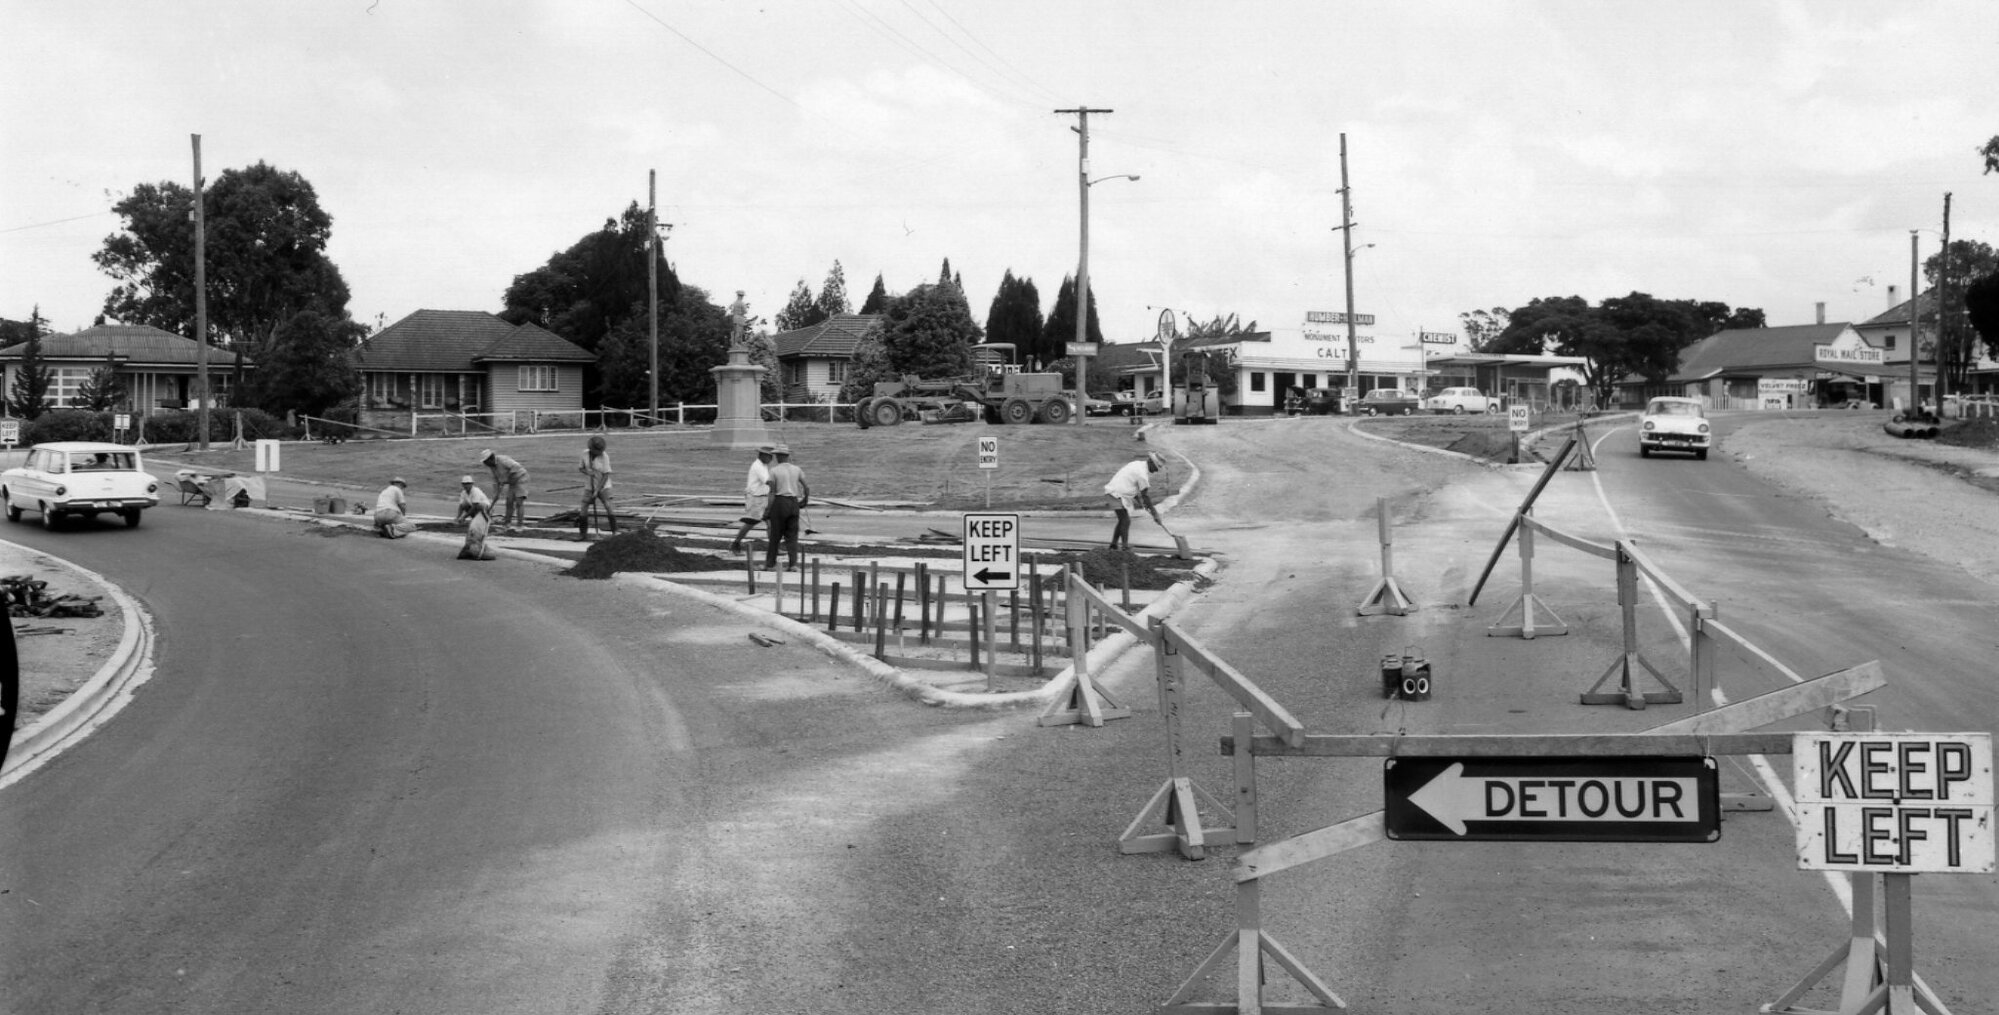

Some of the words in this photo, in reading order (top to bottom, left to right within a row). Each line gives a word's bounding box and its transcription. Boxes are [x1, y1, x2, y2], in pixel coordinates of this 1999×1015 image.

[1304, 333, 1341, 342] MONUMENT
[1348, 335, 1375, 343] TORS
[1423, 332, 1456, 343] CHEMIST
[1317, 347, 1361, 359] CALTX
[1819, 348, 1838, 359] ROYAL
[1840, 349, 1857, 360] MAIL
[1860, 350, 1880, 361] STORE
[1511, 408, 1526, 418] NO
[980, 441, 996, 453] NO
[980, 455, 996, 464] ENTRY
[969, 520, 1014, 538] KEEP
[970, 544, 1013, 562] LEFT
[1819, 739, 1973, 800] KEEP
[1485, 778, 1685, 819] DETOUR
[1823, 806, 1974, 867] LEFT
